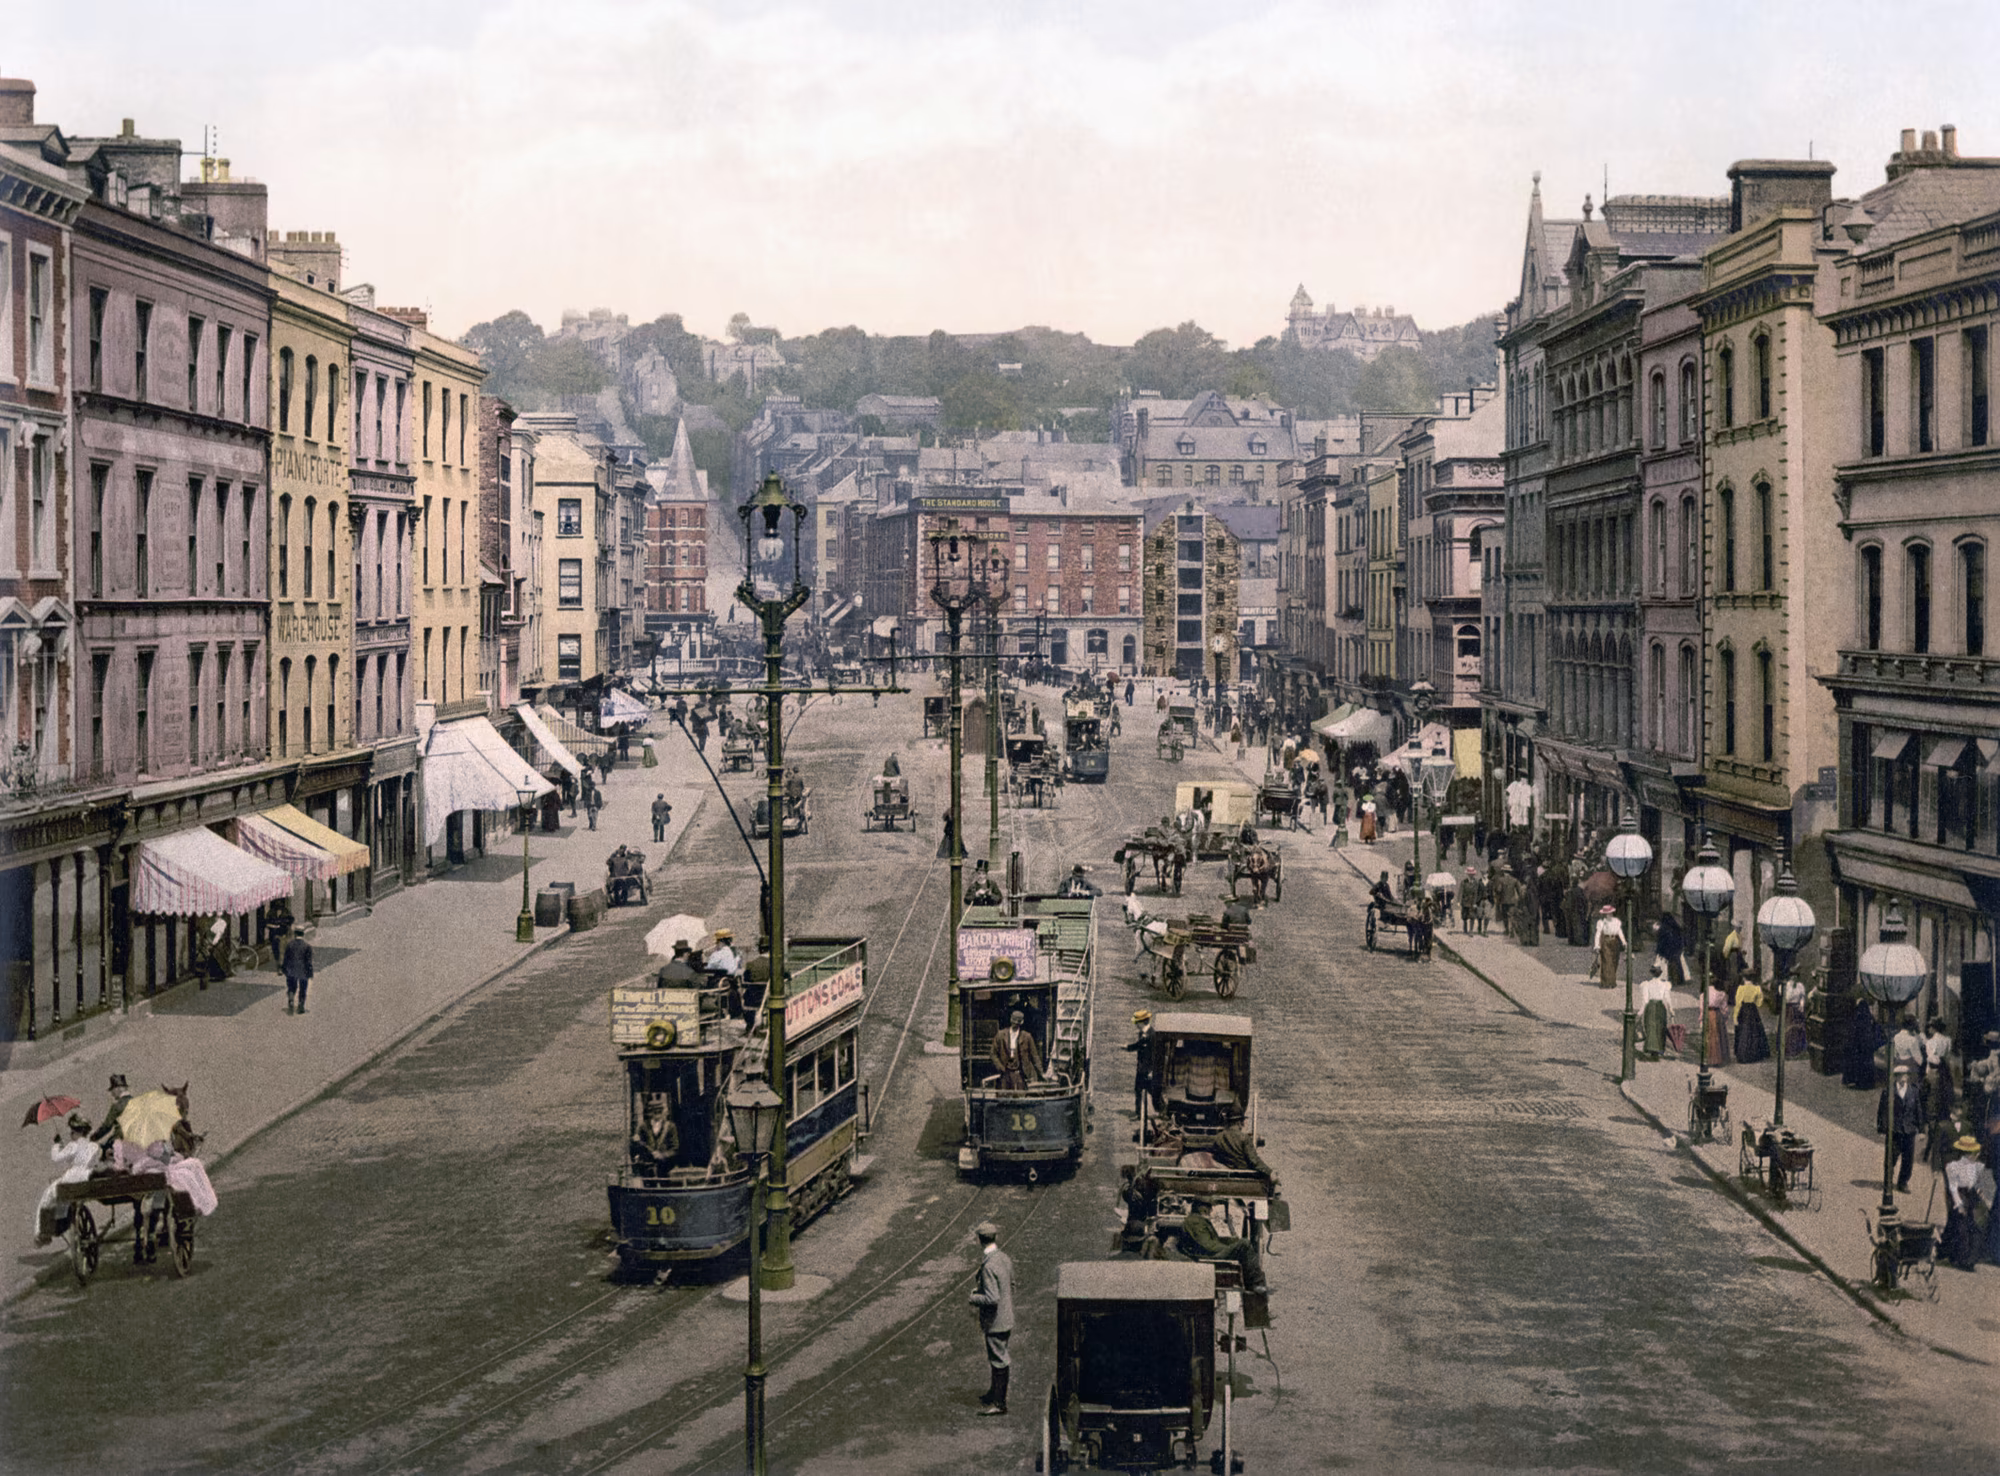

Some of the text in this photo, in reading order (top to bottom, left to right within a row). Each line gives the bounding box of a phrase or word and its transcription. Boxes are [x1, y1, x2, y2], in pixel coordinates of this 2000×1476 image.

[921, 499, 1001, 507] THE STANDARD HOUSE
[277, 614, 341, 643] WAREHOUSE
[959, 932, 993, 950] BAKER
[998, 930, 1032, 951] WRIGHT
[785, 984, 830, 1026] UTTONS
[646, 1206, 675, 1225] 10
